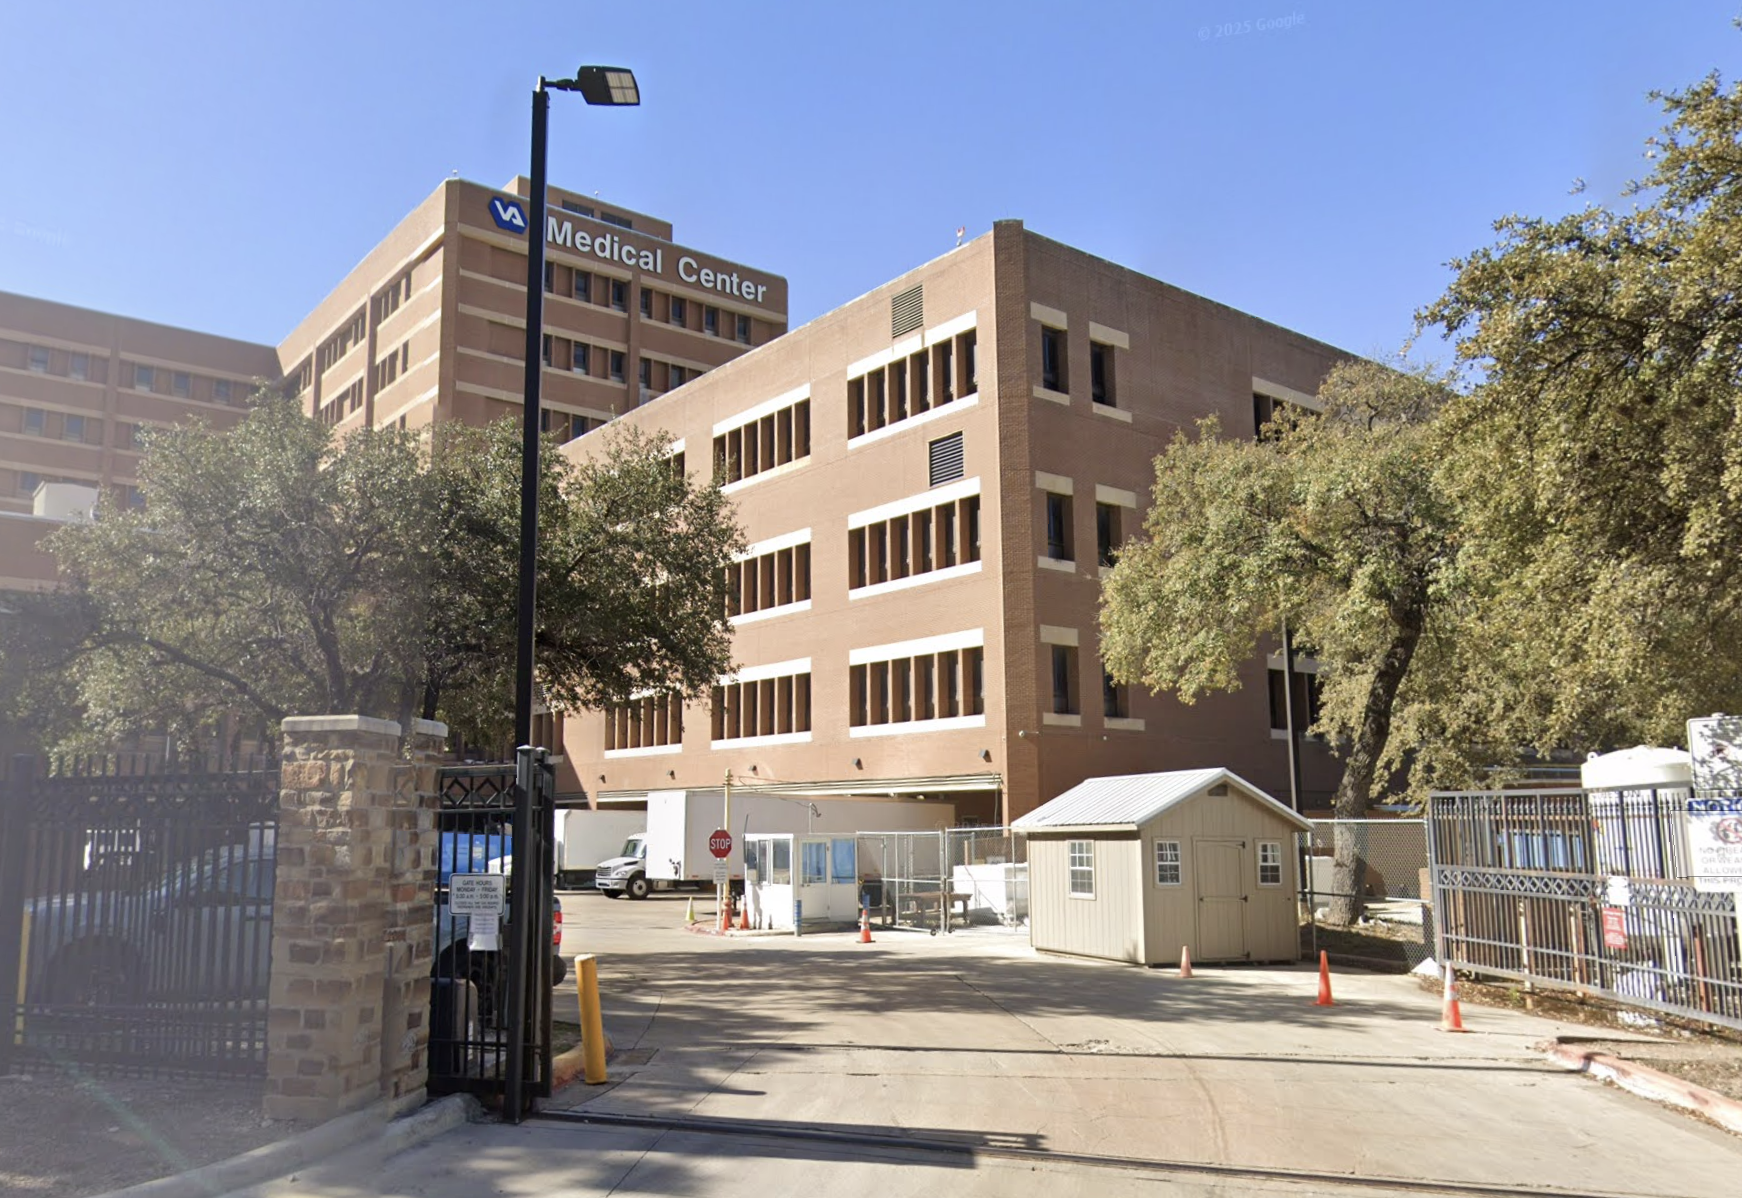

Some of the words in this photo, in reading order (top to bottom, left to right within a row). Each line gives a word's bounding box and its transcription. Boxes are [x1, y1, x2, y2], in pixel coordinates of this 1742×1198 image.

[493, 199, 526, 228] VA
[546, 216, 663, 274] Medical
[678, 256, 767, 303] Center
[710, 838, 731, 849] STOP
